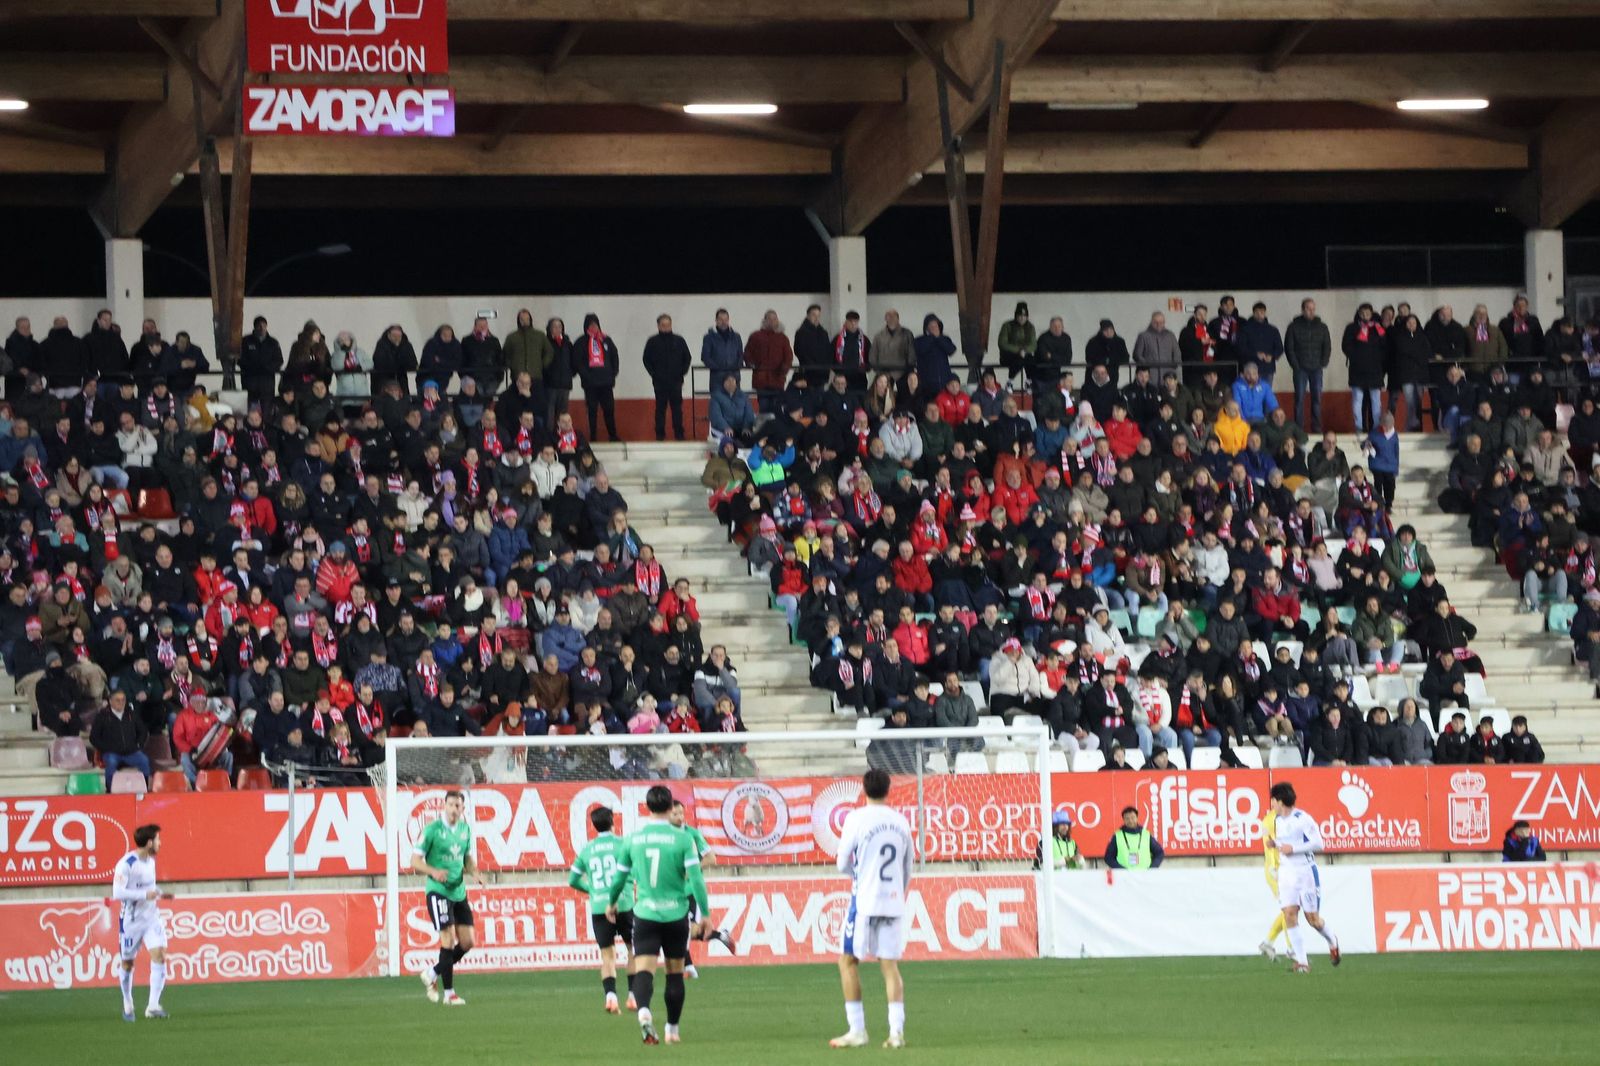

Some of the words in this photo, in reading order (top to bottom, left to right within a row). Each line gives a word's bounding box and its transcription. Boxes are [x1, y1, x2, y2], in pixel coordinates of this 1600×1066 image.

[270, 38, 426, 72] FUNDACIÓN
[979, 796, 1101, 830] ÓPTCO
[1160, 775, 1260, 823] fisio
[1532, 827, 1600, 844] UNTAMI
[589, 854, 616, 890] 22
[645, 847, 661, 889] 7
[879, 843, 897, 882] 2
[707, 889, 942, 957] ZAMOA
[945, 887, 1025, 952] CF
